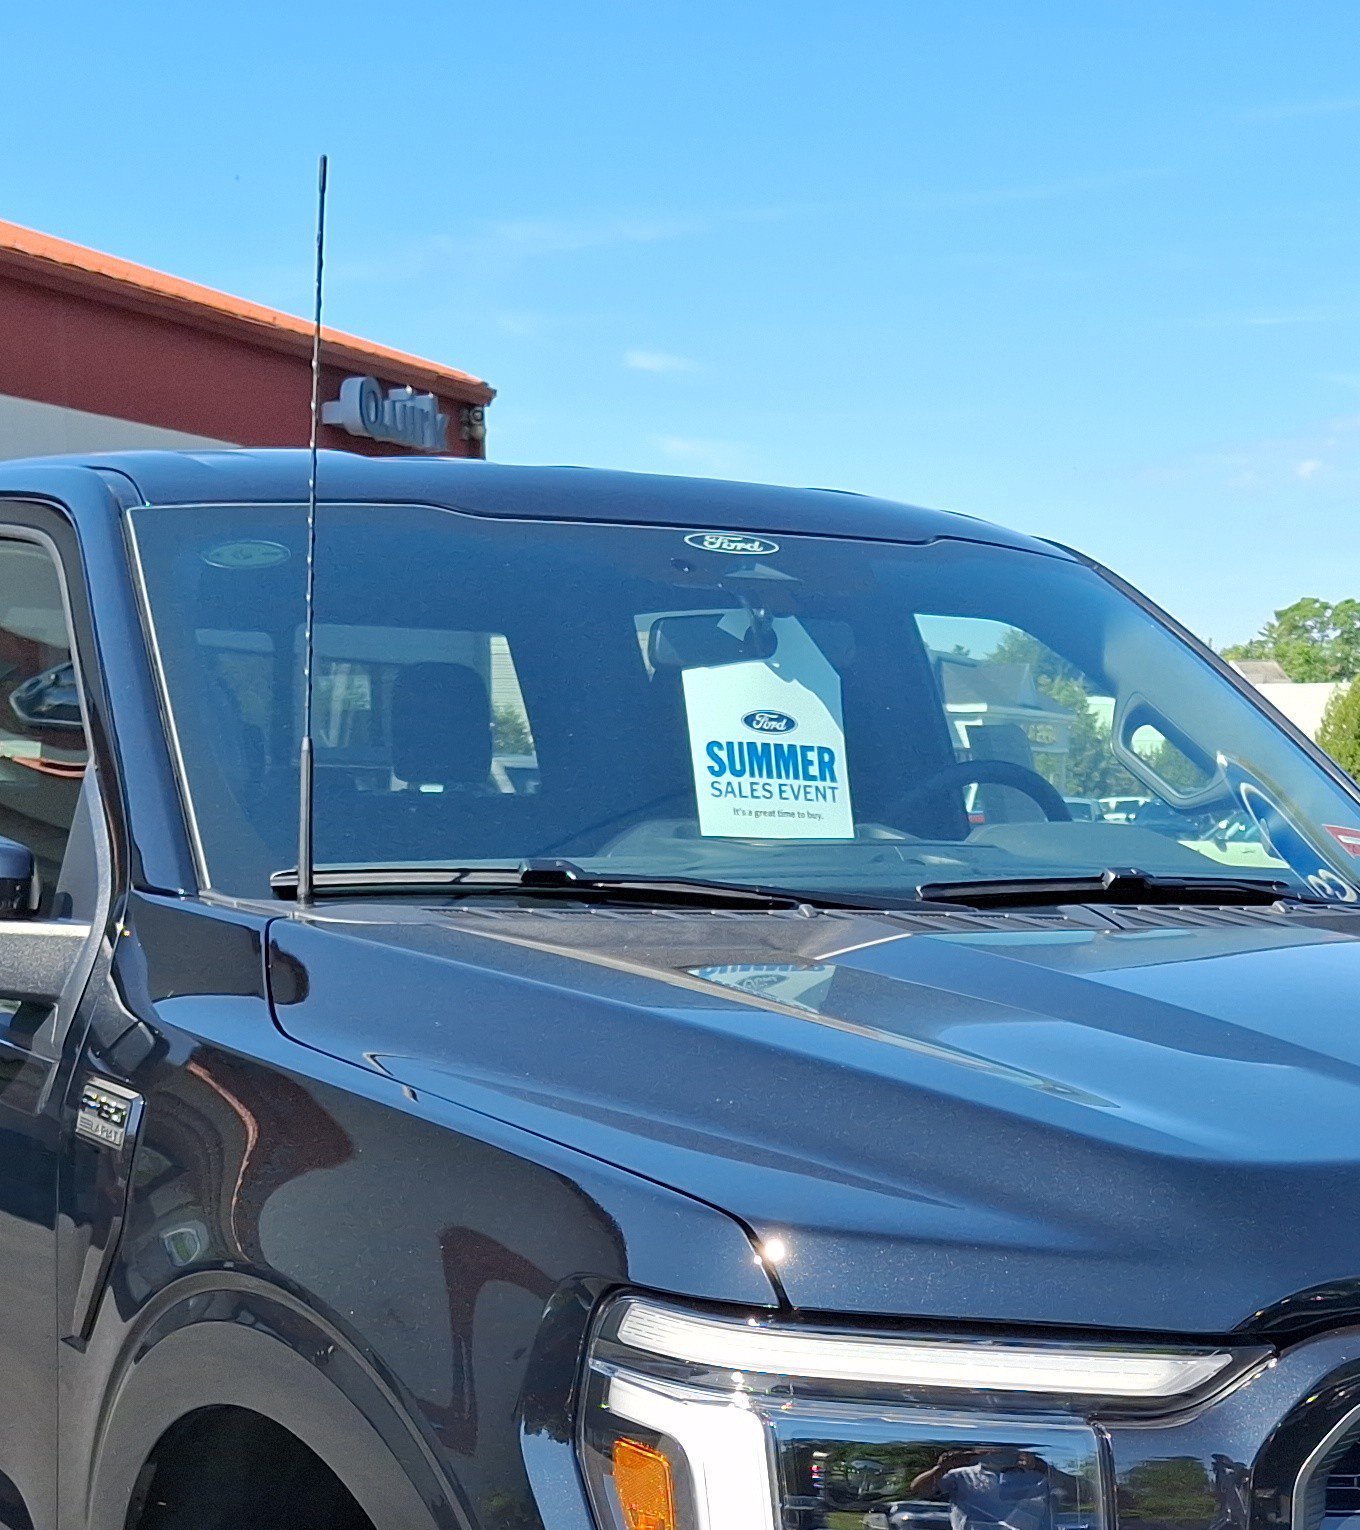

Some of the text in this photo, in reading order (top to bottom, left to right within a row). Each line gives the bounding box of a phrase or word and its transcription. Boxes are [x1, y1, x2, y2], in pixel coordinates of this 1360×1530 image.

[703, 535, 764, 552] Ford
[752, 712, 789, 731] Ford
[705, 740, 838, 783] SUMMER
[710, 780, 839, 803] SALES EVENT
[733, 807, 747, 816] It's
[754, 809, 777, 819] great
[777, 809, 796, 819] time
[797, 810, 806, 819] to
[806, 810, 825, 821] buy.
